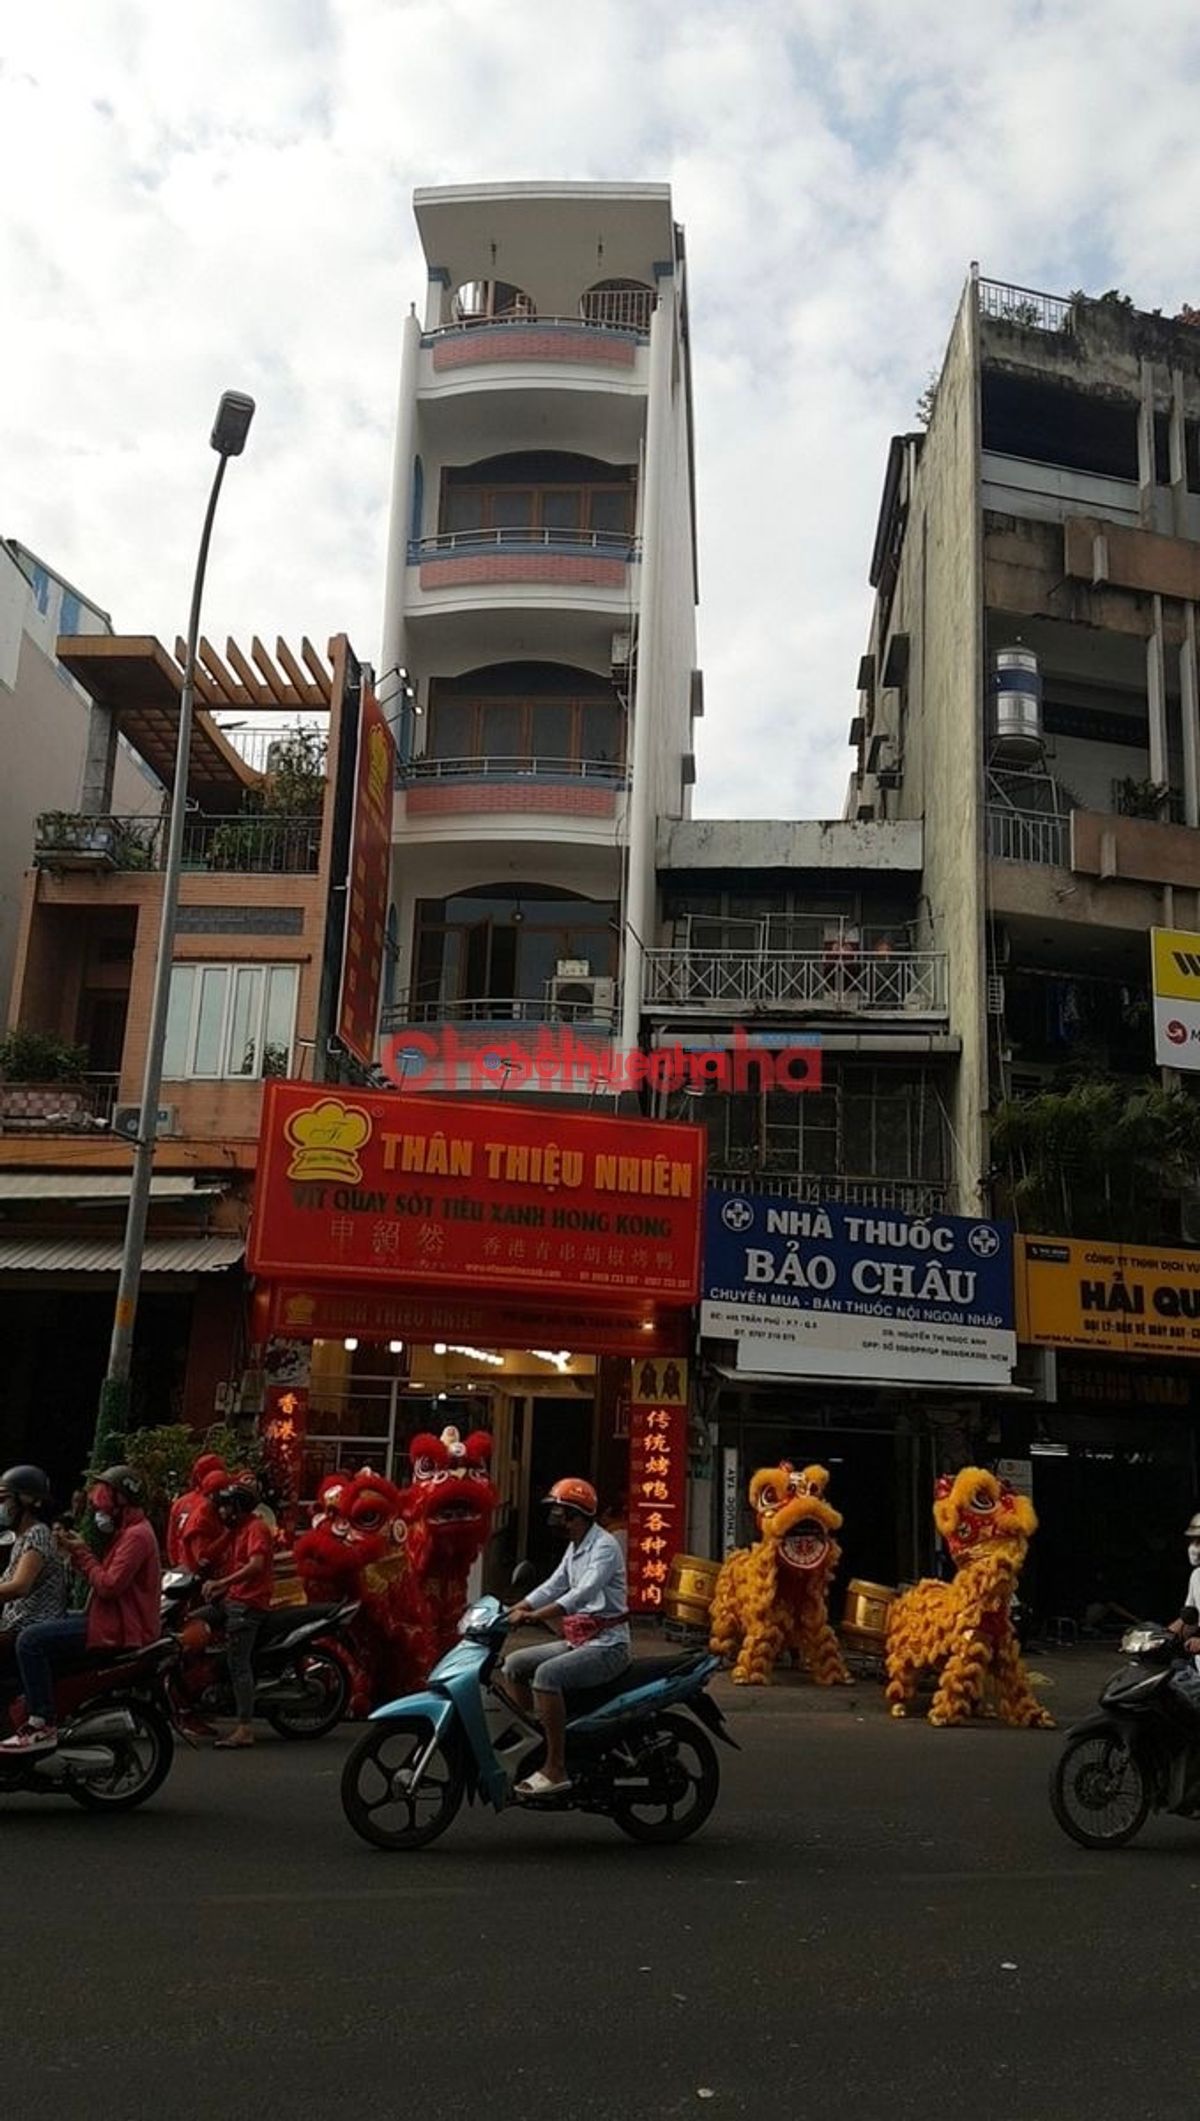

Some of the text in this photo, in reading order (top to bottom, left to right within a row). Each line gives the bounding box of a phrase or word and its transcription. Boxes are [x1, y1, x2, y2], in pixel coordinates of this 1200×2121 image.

[381, 1131, 691, 1198] THÂN THIỆU NHIÊN
[334, 1188, 388, 1213] QUAY
[491, 1201, 545, 1227] XANH
[552, 1207, 609, 1232] HONG
[616, 1213, 672, 1238] KONG
[767, 1207, 955, 1253] NHÀ THUỐC
[744, 1240, 976, 1304] BẢO CHÂU
[1084, 1251, 1114, 1264] CÔNG
[1131, 1258, 1158, 1269] TNHH
[1161, 1261, 1184, 1272] DỊCH
[770, 1293, 801, 1307] MUA
[846, 1299, 892, 1317] THUỐC
[896, 1304, 919, 1321] NỘI
[1081, 1271, 1144, 1314] HẢI
[640, 1410, 671, 1604] 传统烤鸭 各种烤肉
